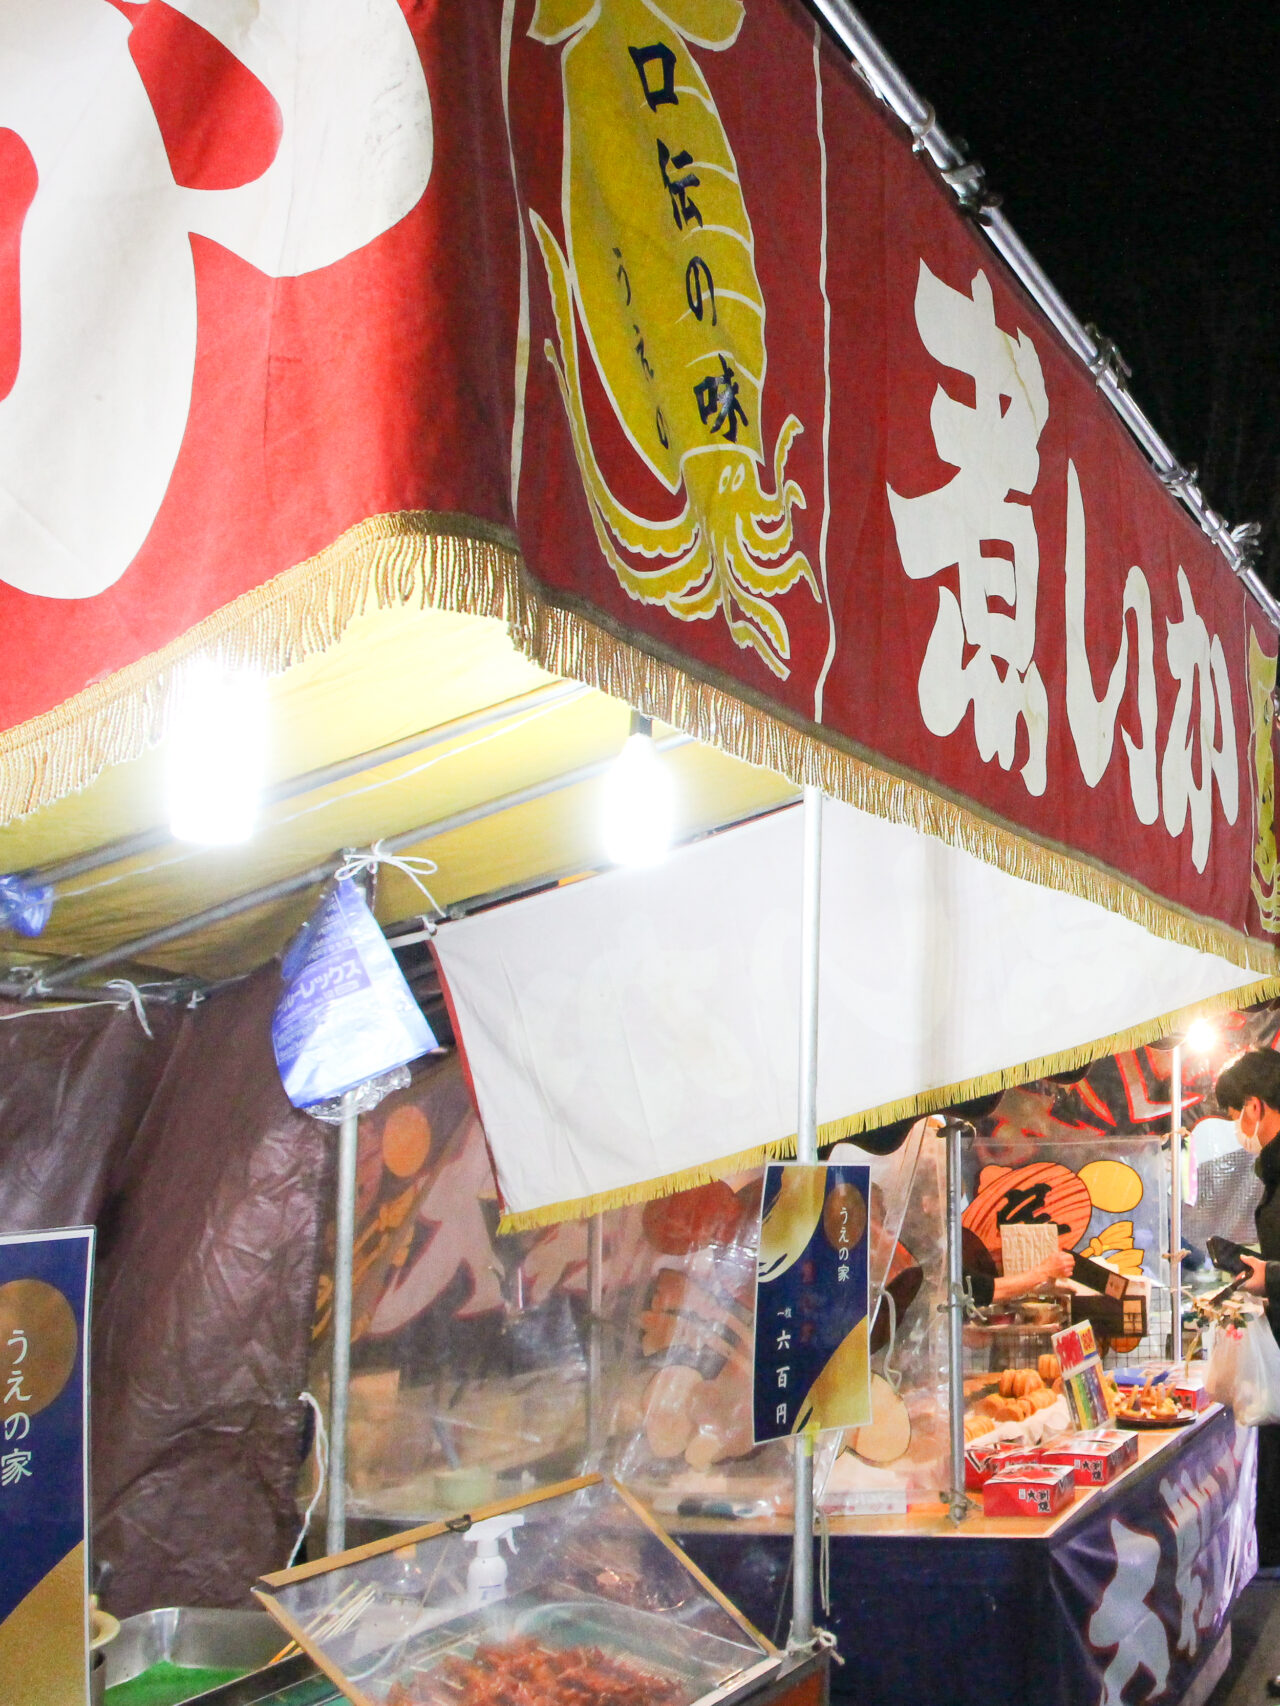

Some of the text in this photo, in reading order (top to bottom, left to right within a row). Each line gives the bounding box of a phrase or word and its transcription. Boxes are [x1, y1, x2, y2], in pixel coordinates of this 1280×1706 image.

[628, 42, 748, 443] 口伝の味
[837, 1207, 850, 1282] うえの家
[1, 1330, 33, 1487] うえの家
[776, 1329, 791, 1425] 六百円
